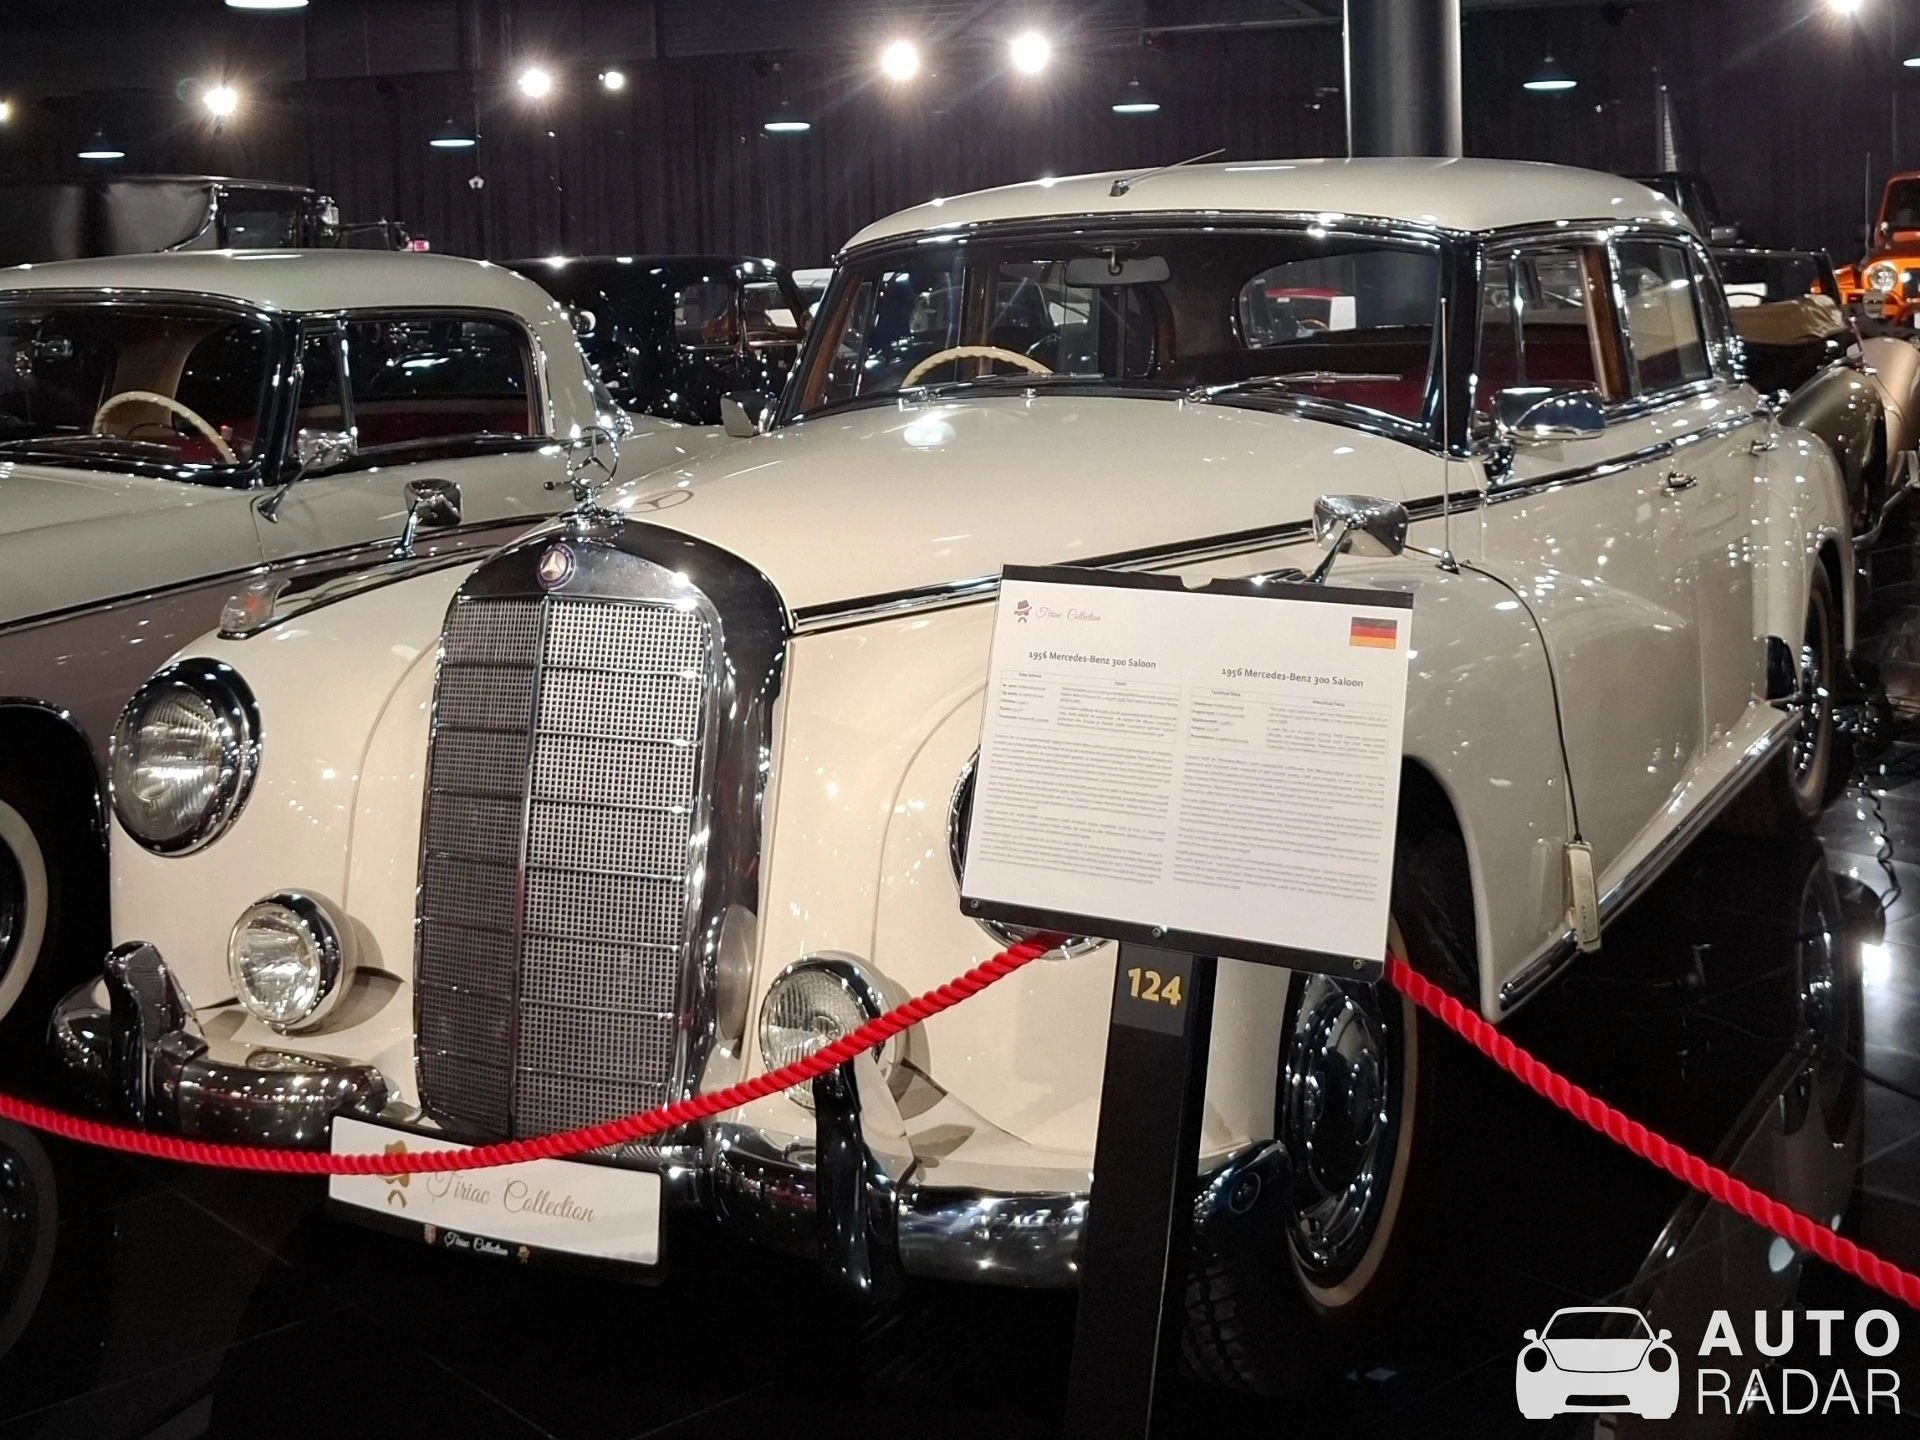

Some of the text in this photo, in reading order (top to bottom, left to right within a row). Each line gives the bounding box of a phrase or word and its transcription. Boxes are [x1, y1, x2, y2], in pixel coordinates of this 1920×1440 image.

[1028, 650, 1157, 669] 1956 Mercedes-Benz 300 Saloon
[1221, 667, 1364, 688] 1956 Mercedes-Benz 300 Saloon
[1127, 967, 1182, 1006] 124
[503, 1177, 595, 1222] Collection
